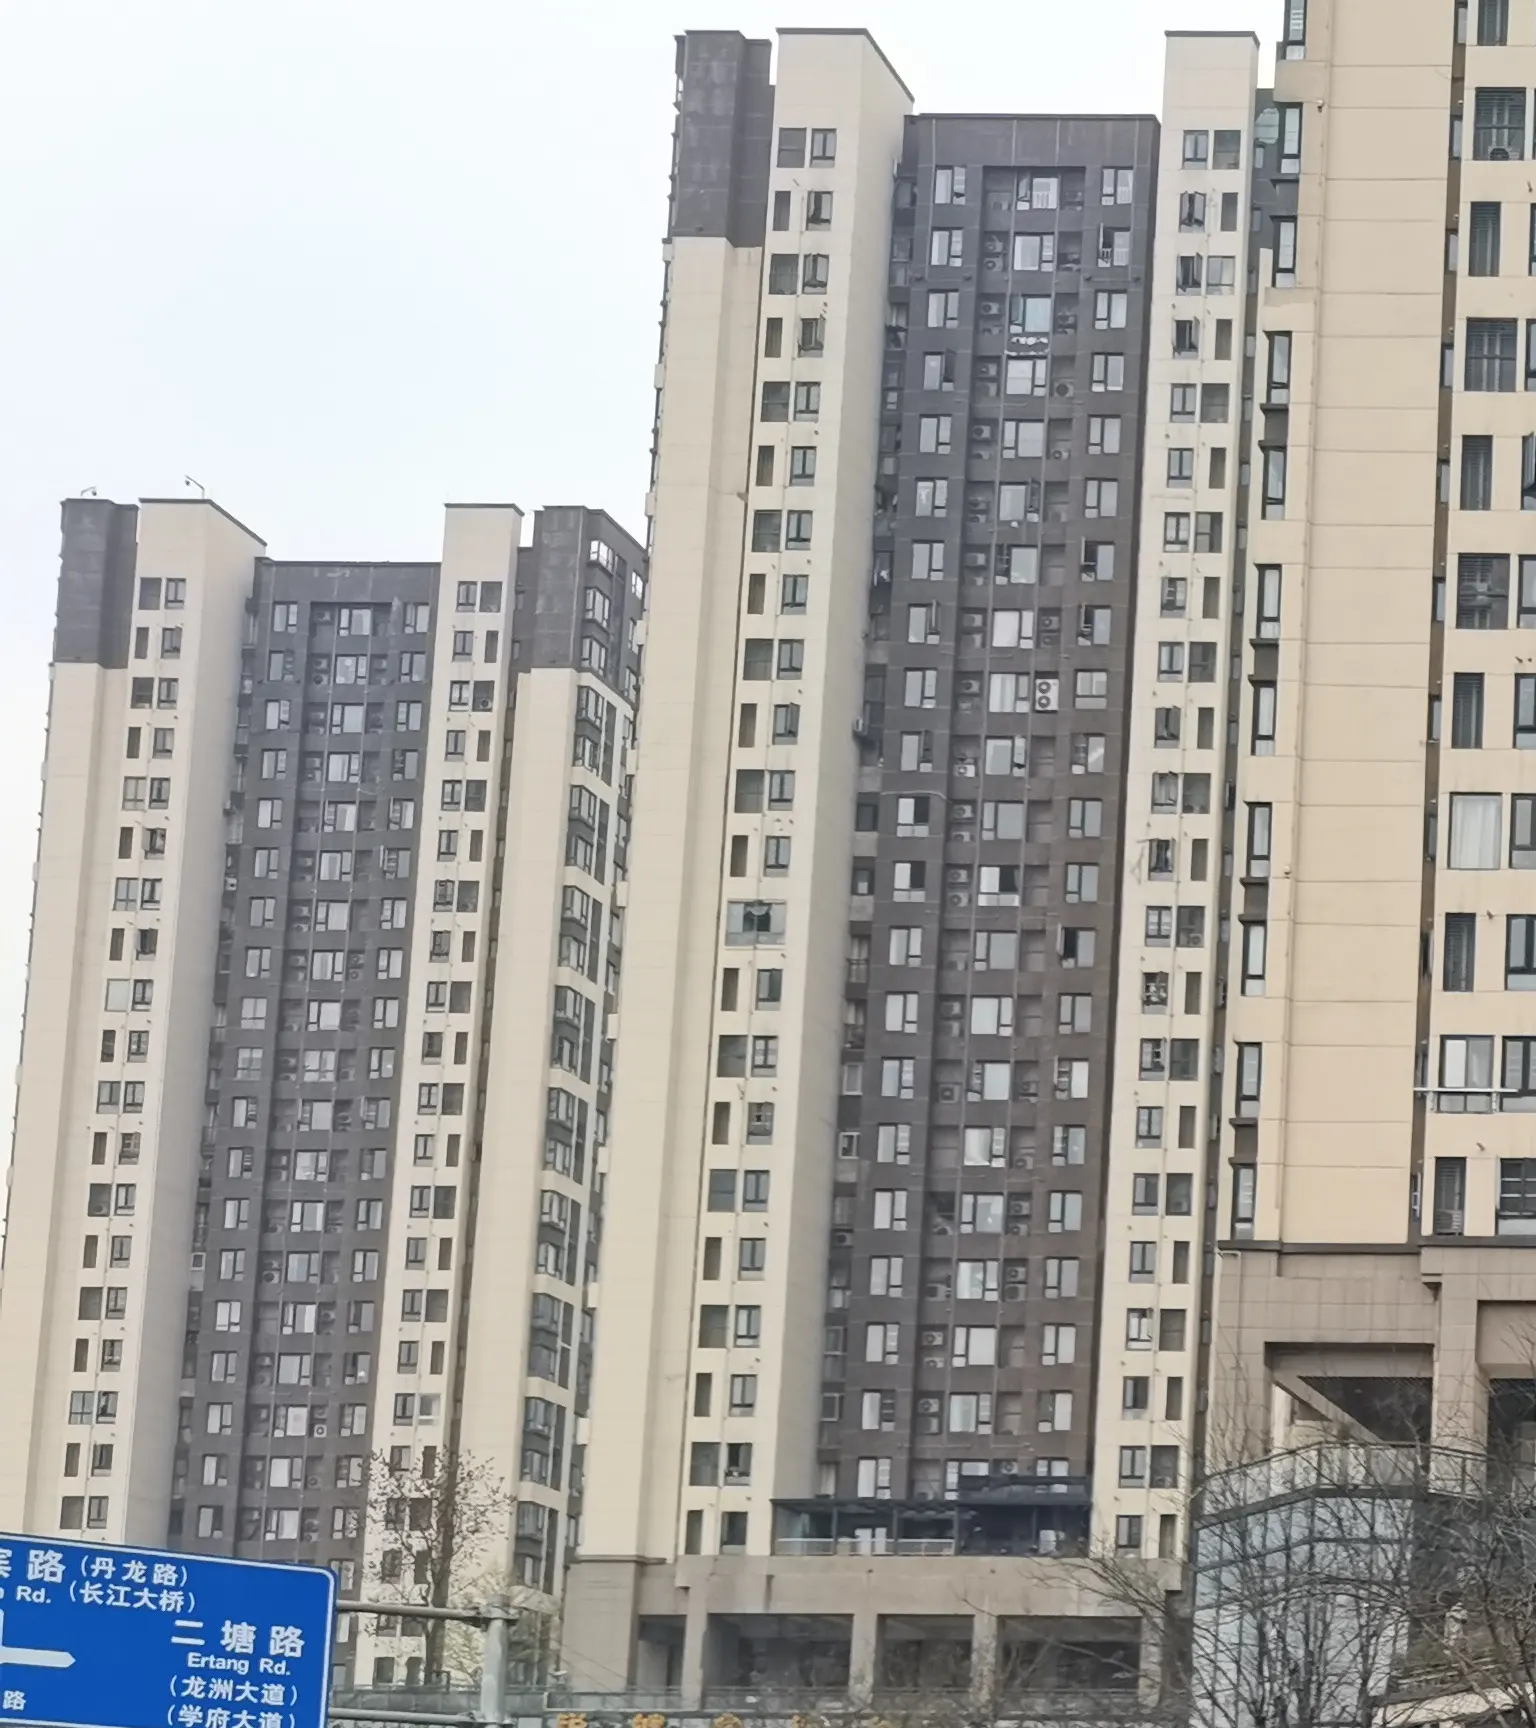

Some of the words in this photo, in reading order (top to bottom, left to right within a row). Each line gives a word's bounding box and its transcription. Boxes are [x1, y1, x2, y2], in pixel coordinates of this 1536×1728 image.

[81, 1554, 188, 1588] （丹龙路）
[16, 1585, 52, 1604] Rd.
[69, 1579, 196, 1614] （长江大桥）
[171, 1619, 305, 1659] 二塘路
[187, 1651, 250, 1676] Ertang
[259, 1657, 291, 1677] Rd.
[169, 1674, 298, 1707] （龙洲大道）
